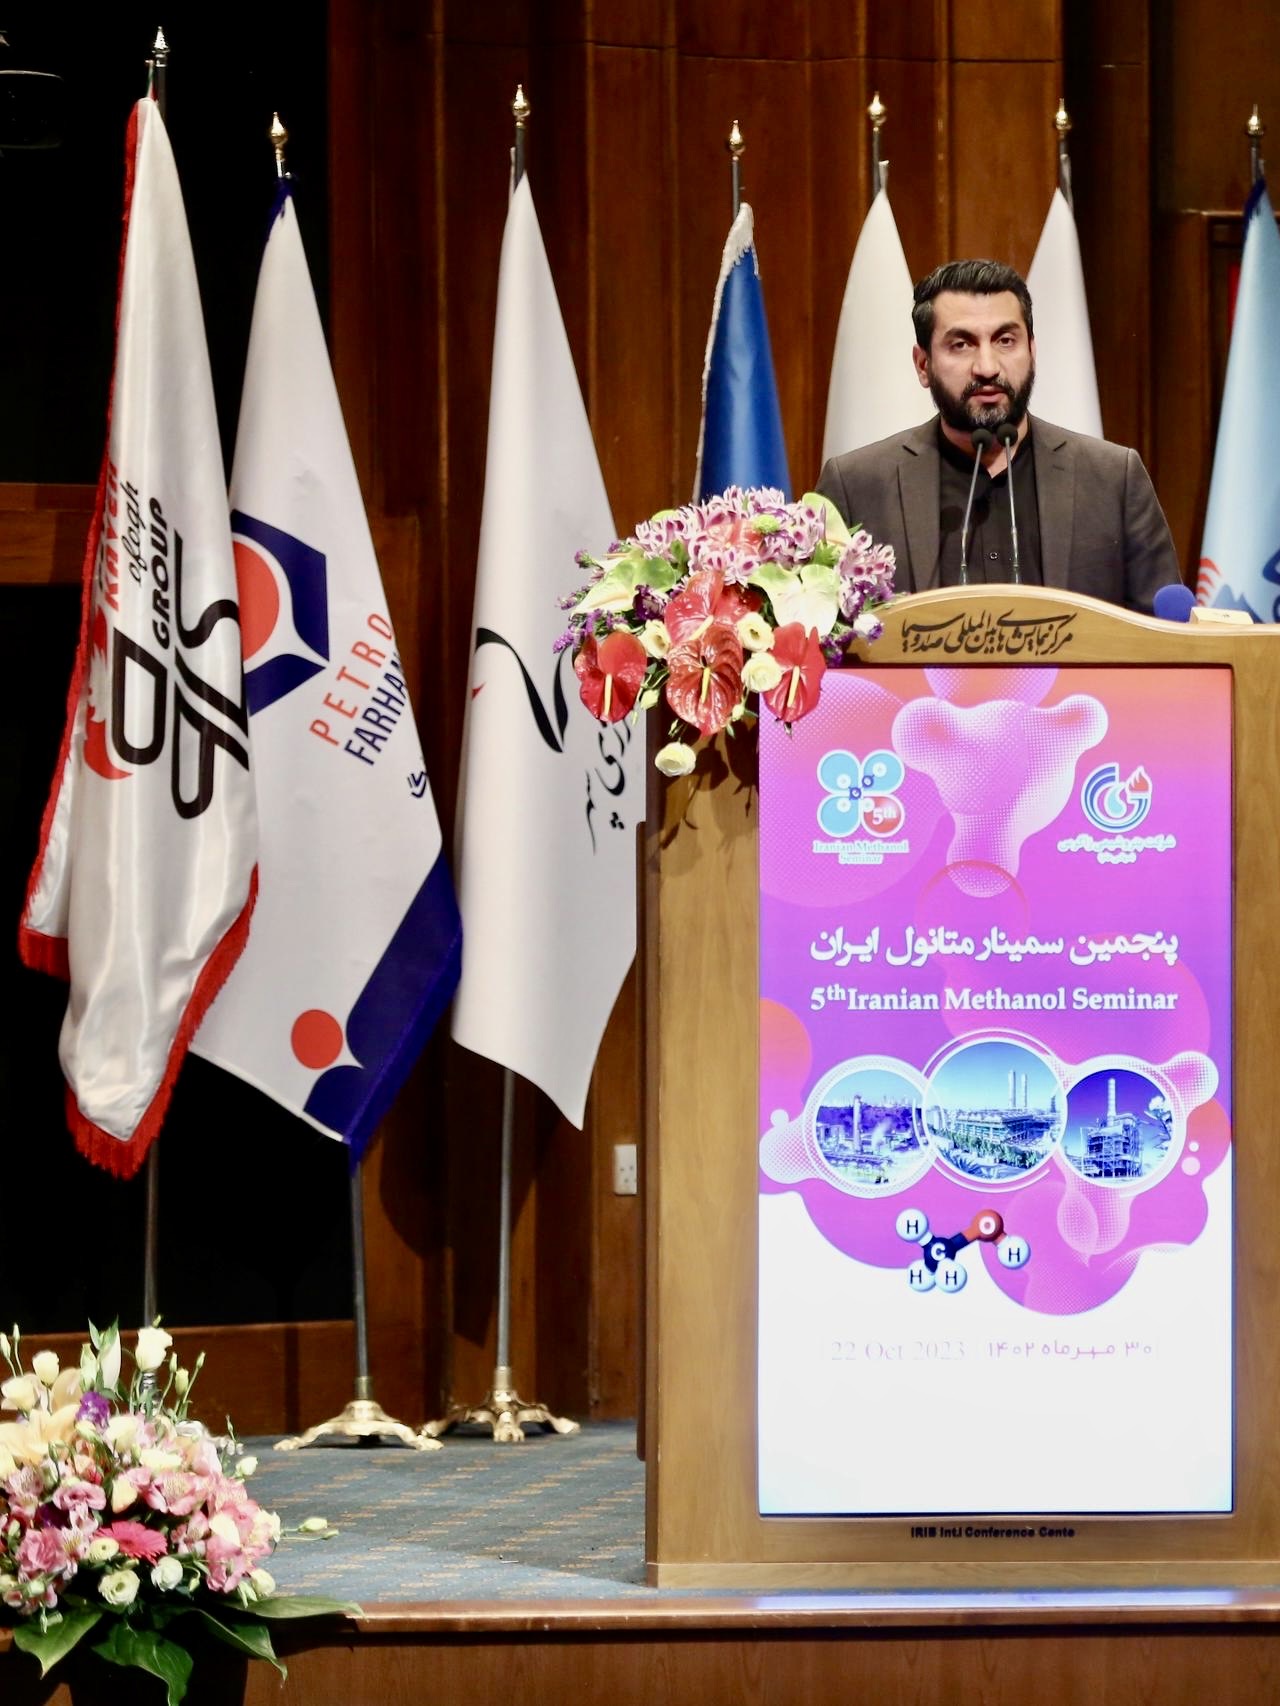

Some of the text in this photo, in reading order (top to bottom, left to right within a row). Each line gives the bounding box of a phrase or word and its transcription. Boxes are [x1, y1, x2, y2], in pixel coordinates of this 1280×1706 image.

[149, 497, 170, 650] GROUP
[1040, 612, 1077, 655] مرکز
[309, 613, 394, 746] PETRO
[810, 926, 1179, 967] پنجمین سمینار متانول ایران
[810, 983, 1178, 1011] 5th Iranian Methanol Seminar
[907, 1219, 919, 1235] H
[979, 1216, 996, 1235] O
[931, 1242, 946, 1261] C
[1008, 1247, 1020, 1262] H
[910, 1269, 922, 1284] H
[945, 1270, 957, 1285] H
[831, 1340, 966, 1360] 22 Oct 2023
[988, 1341, 1035, 1357] ۱۴۰۲
[1124, 1341, 1153, 1357] ۳۰
[965, 1526, 1035, 1538] Conference
